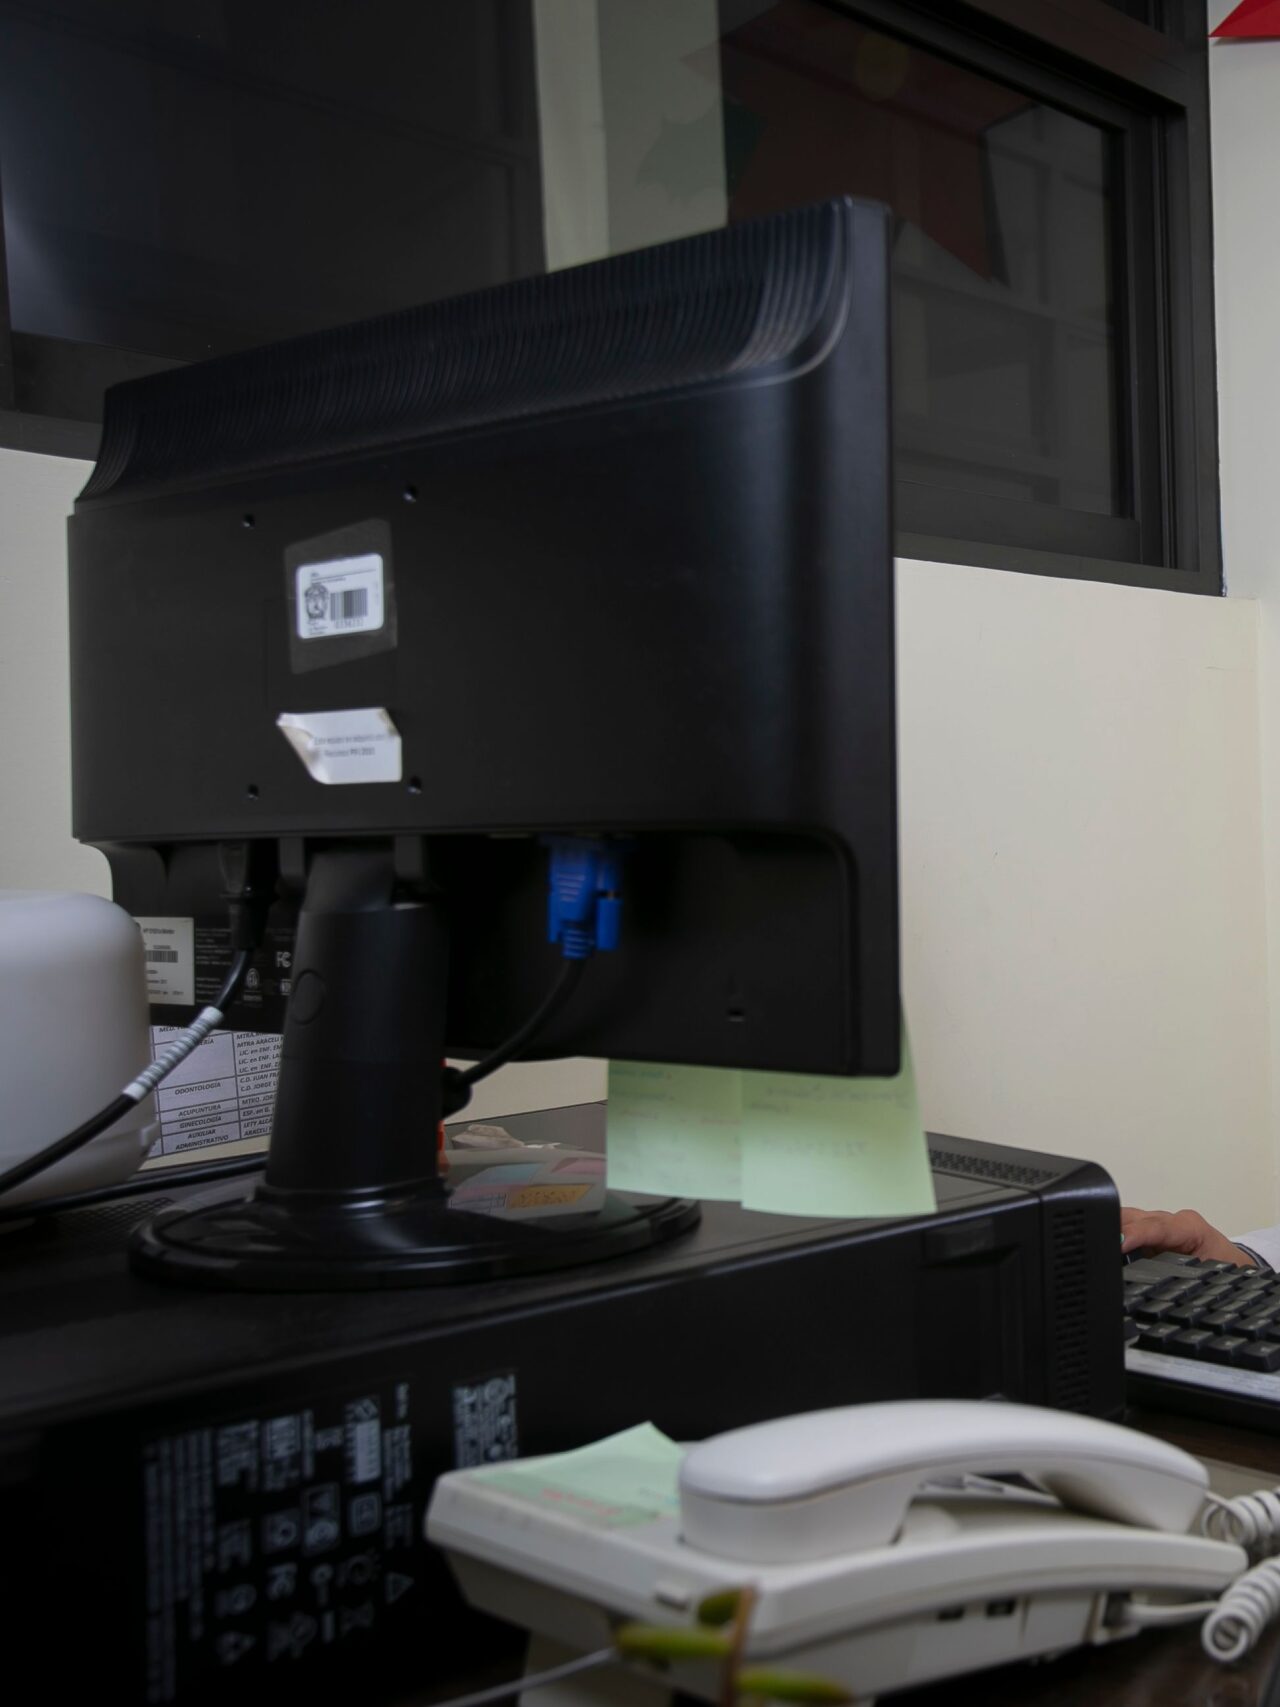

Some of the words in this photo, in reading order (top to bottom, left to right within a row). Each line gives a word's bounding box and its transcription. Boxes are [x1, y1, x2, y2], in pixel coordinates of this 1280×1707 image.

[174, 1082, 221, 1095] ODONTOLOGÍA
[178, 1104, 221, 1117] ACUPUNTURA
[180, 1116, 221, 1129] GINECOLOGÍA
[188, 1129, 216, 1139] AUXILIAR
[176, 1135, 229, 1150] ADMINISTRATIVO
